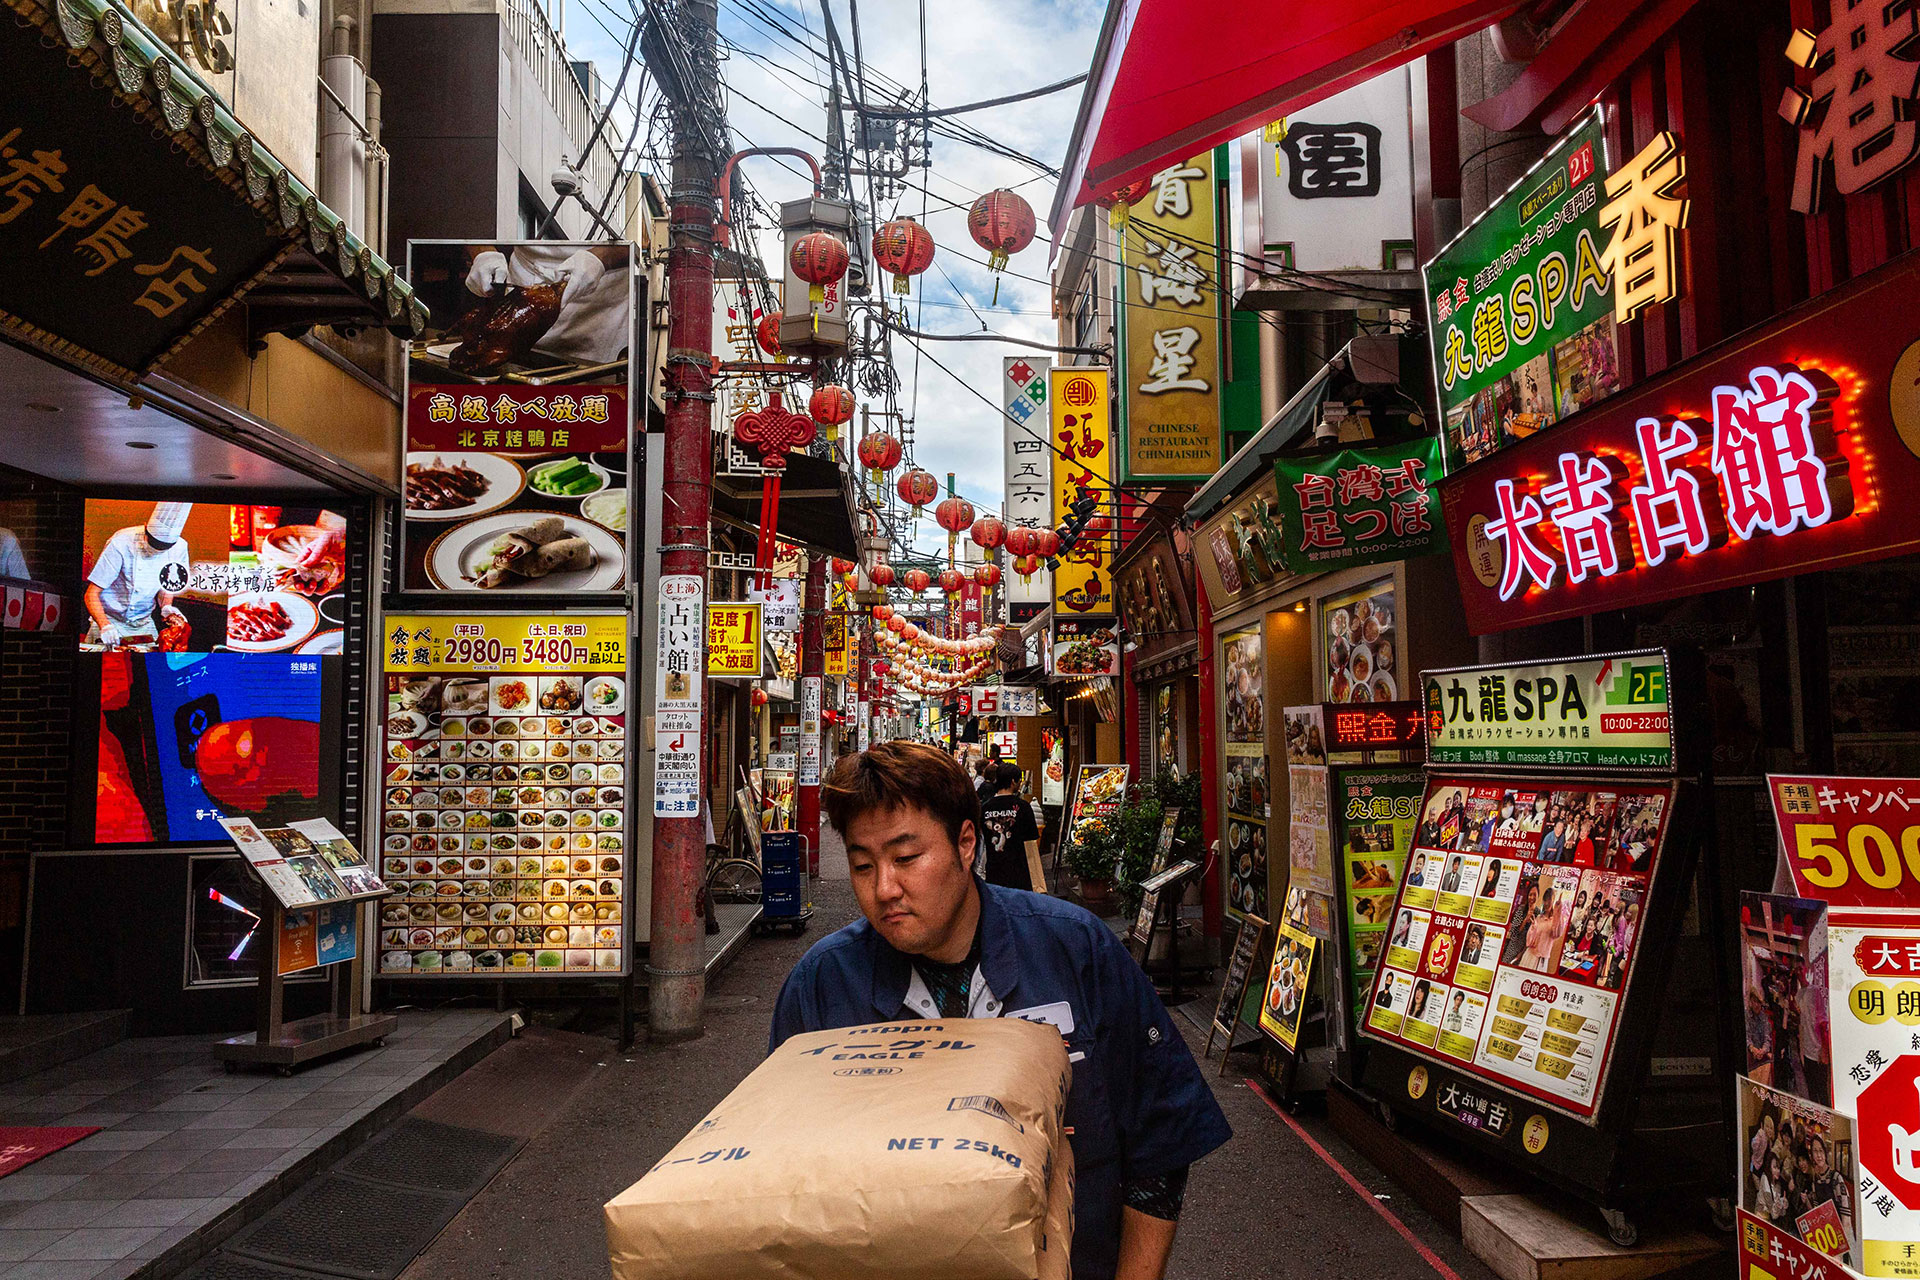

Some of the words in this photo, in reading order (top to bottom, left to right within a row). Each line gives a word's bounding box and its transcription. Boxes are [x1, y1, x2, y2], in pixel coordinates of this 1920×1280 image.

[1280, 121, 1382, 199] 園
[1570, 147, 1592, 184] 2F
[1599, 131, 1690, 324] 香
[1443, 228, 1614, 391] 九龍SPA
[428, 393, 611, 424] 高級食べ放題
[1148, 423, 1201, 434] CHINESE
[457, 429, 570, 448] 北京烤鴨店
[1139, 436, 1210, 447] RESTAURANT
[1137, 448, 1212, 460] CHINHAISHIN
[1293, 457, 1426, 512] 台湾式
[1484, 365, 1833, 601] 大吉占館
[1299, 494, 1433, 552] 足つぼ
[190, 573, 276, 594] 北京烤鴨店
[665, 583, 695, 594] 老上海
[709, 612, 739, 627] 足度
[740, 610, 754, 644] 1
[764, 615, 785, 627] 本館
[596, 641, 620, 652] 130
[667, 603, 690, 671] 占い館
[445, 638, 517, 664] 2980円
[522, 638, 588, 664] 3480円
[589, 652, 625, 665] 品以上
[708, 655, 754, 668] べ放題
[176, 666, 210, 687] ニュース
[1633, 671, 1663, 703] 2F
[978, 690, 998, 711] 占
[1446, 673, 1589, 724] 九龍SPA
[661, 722, 692, 730] 四柱推命
[1603, 717, 1669, 730] 10:00-22:00
[658, 753, 696, 761] 中華街通り
[1442, 750, 1462, 762] 足つぼ
[1469, 750, 1485, 761] Body
[1485, 750, 1500, 762] 整体
[1507, 751, 1517, 762] Oil
[1548, 750, 1590, 764] 全身アロマ
[1598, 753, 1618, 765] Head
[1618, 752, 1669, 766] ヘッドスパ
[1783, 785, 1810, 797] 手相
[655, 801, 697, 812] 車に注意
[984, 808, 1018, 818] GREMLINS
[1787, 800, 1813, 812] 両手
[1522, 982, 1557, 1001] 明朗会計
[799, 1039, 977, 1056] イーグル
[831, 1051, 926, 1061] EAGLE
[844, 1066, 895, 1077] 小麦粉
[1849, 1050, 1890, 1086] 恋愛
[1442, 1082, 1461, 1110] 大
[1461, 1092, 1489, 1115] 占い館
[1488, 1100, 1508, 1130] 吉
[1461, 1112, 1479, 1128] 2号店
[1527, 1120, 1544, 1151] 手相
[886, 1137, 945, 1151] NET
[953, 1137, 1023, 1168] 25kg
